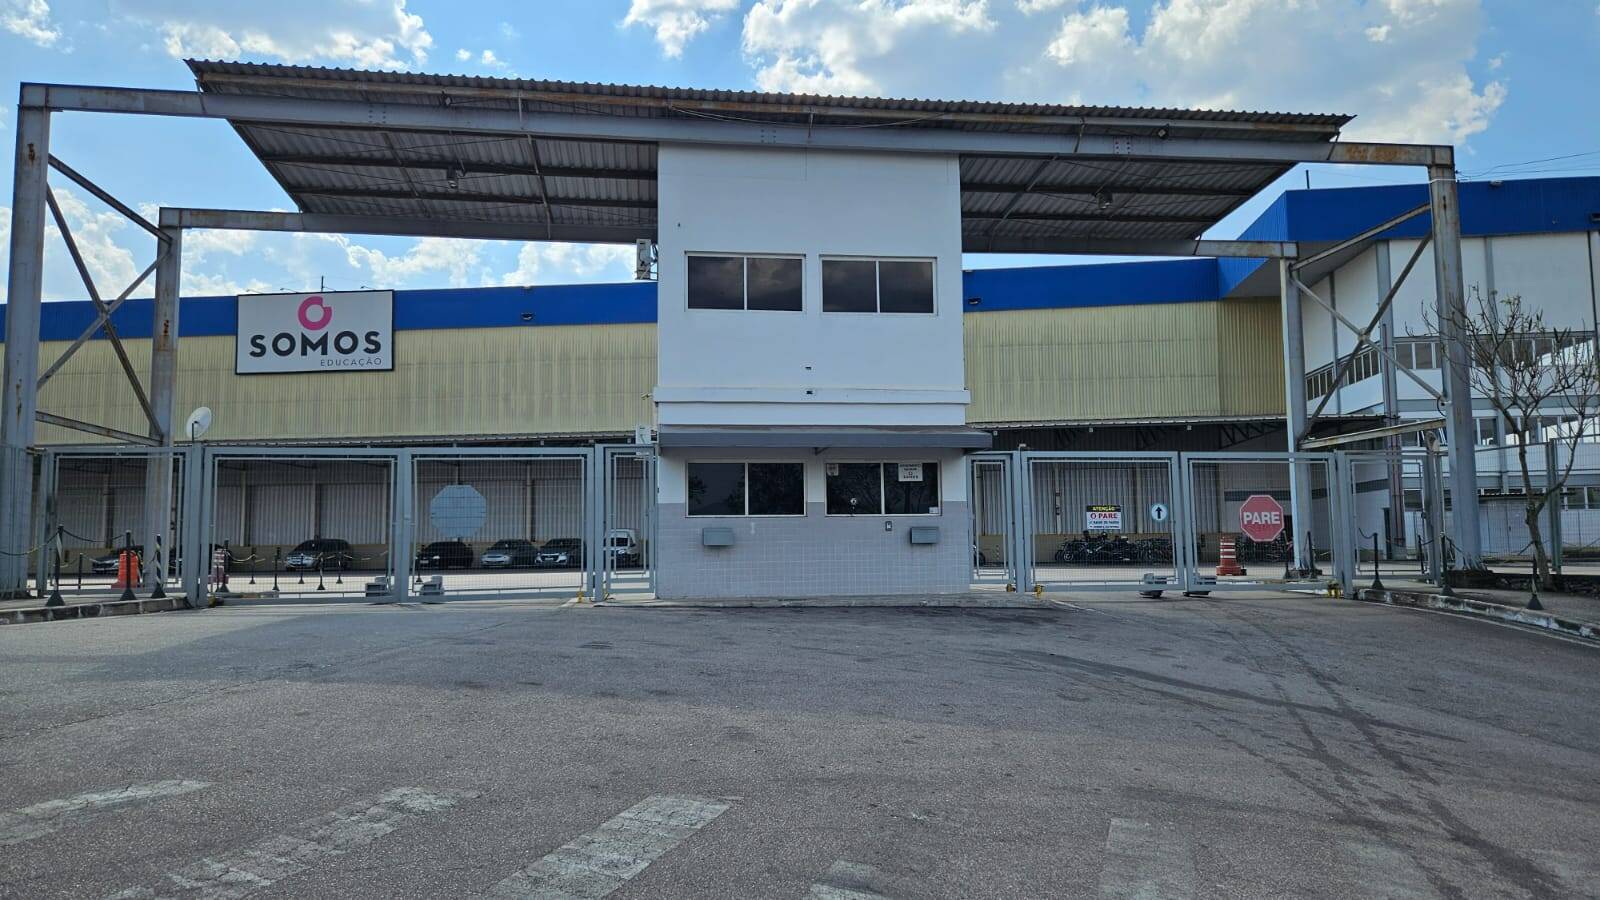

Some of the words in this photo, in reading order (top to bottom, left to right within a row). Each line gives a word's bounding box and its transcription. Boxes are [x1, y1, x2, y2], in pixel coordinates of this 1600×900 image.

[250, 331, 381, 357] SOMOS
[320, 357, 382, 367] EDUCAÇÃO
[1243, 511, 1281, 525] PARE
